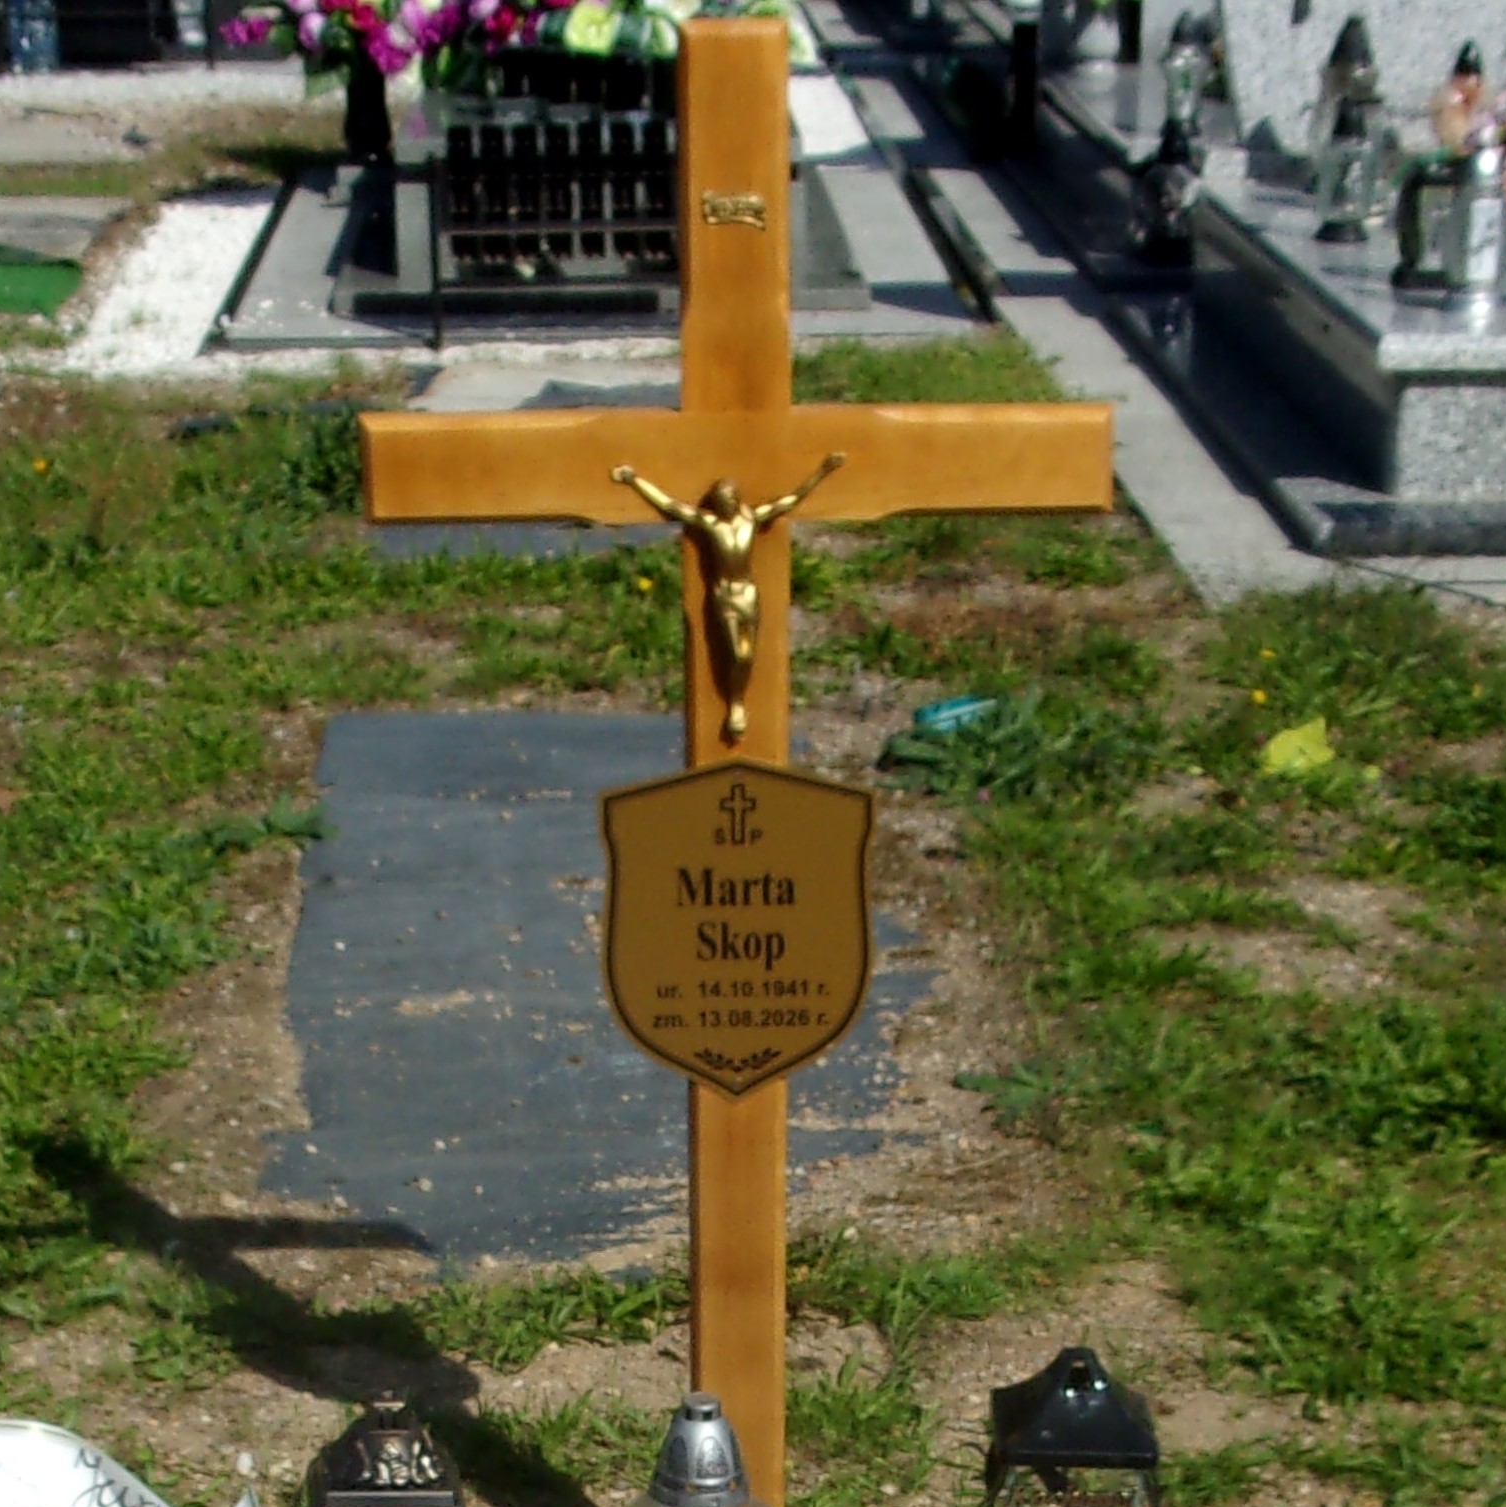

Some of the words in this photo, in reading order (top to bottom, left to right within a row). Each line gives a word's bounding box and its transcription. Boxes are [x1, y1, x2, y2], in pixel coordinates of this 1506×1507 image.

[750, 828, 764, 845] P
[676, 867, 796, 907] Marta
[695, 921, 786, 971] Skop
[657, 984, 683, 998] ur.
[698, 979, 809, 999] 14.10.1941
[816, 981, 830, 997] r.
[652, 1013, 688, 1029] zm.
[698, 1008, 809, 1028] 13.08.2026
[816, 1010, 830, 1026] r.
